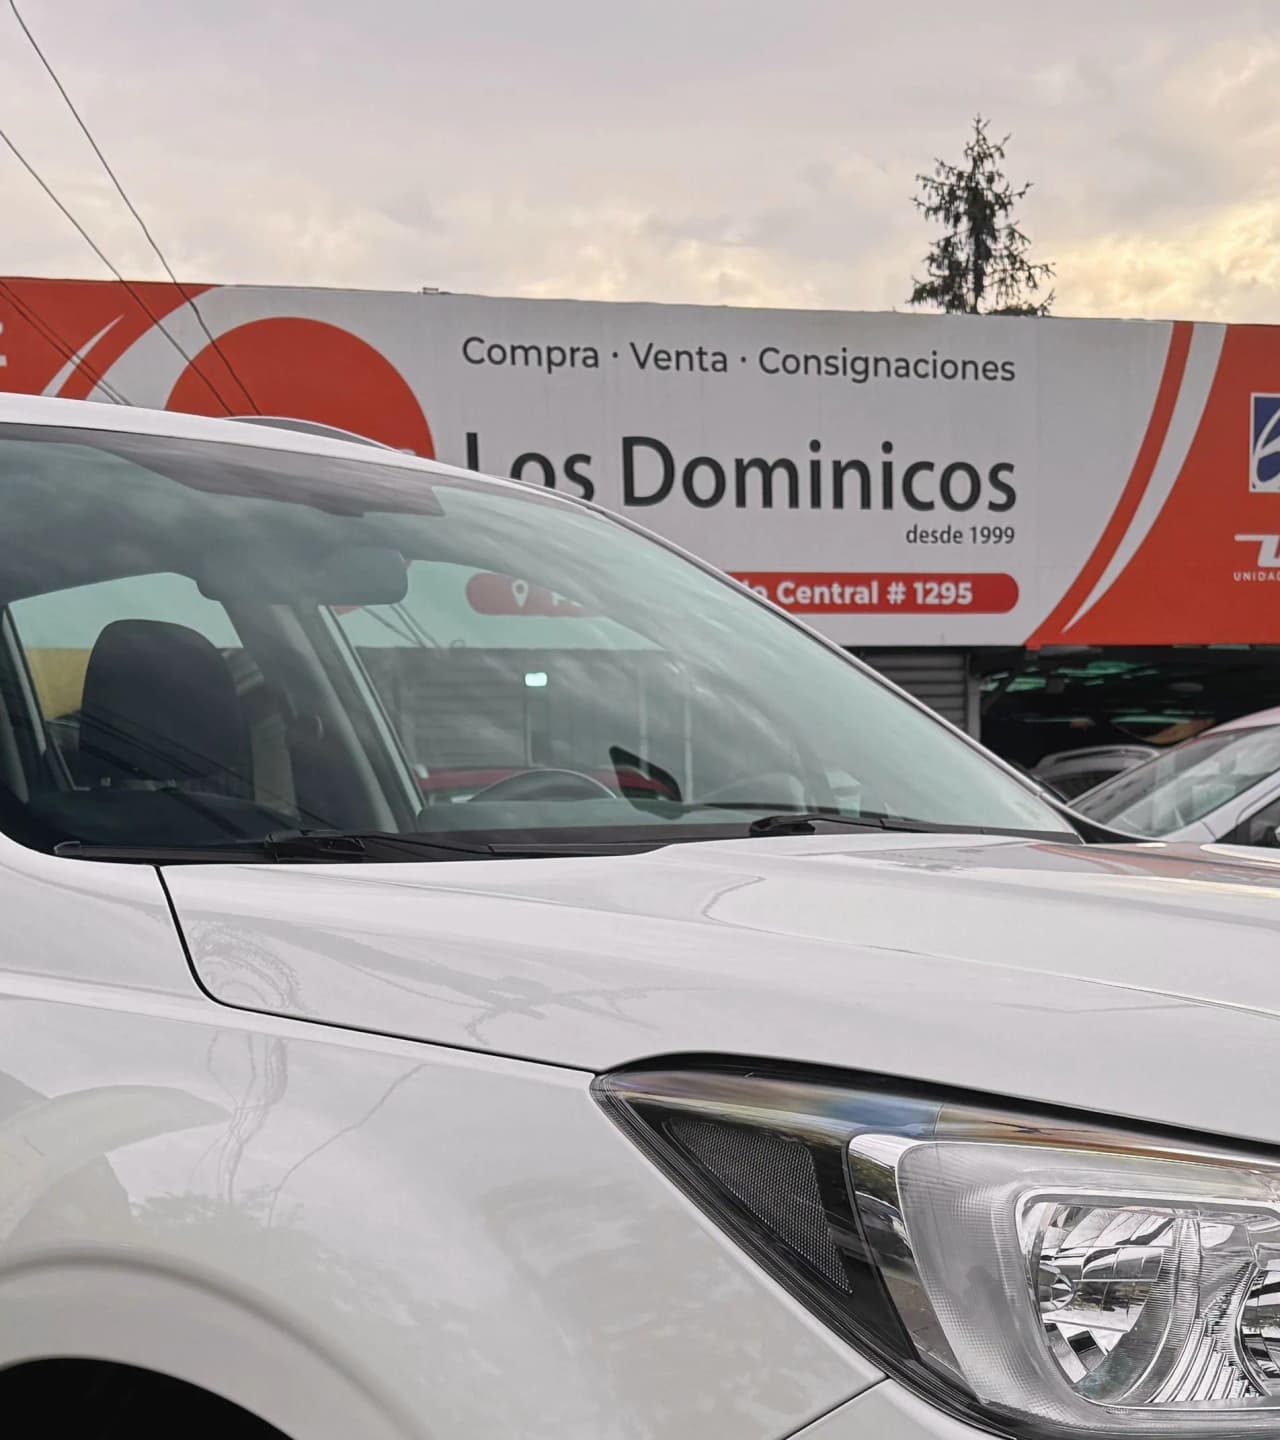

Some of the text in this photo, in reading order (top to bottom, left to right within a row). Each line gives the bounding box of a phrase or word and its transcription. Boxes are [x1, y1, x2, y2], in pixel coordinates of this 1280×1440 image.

[461, 336, 1016, 384] Compra Venta Consignaciones
[620, 435, 1018, 513] Dominicos
[905, 523, 1016, 545] desde 1999
[776, 580, 878, 605] Central
[887, 582, 907, 603] #
[912, 581, 974, 606] 1295
